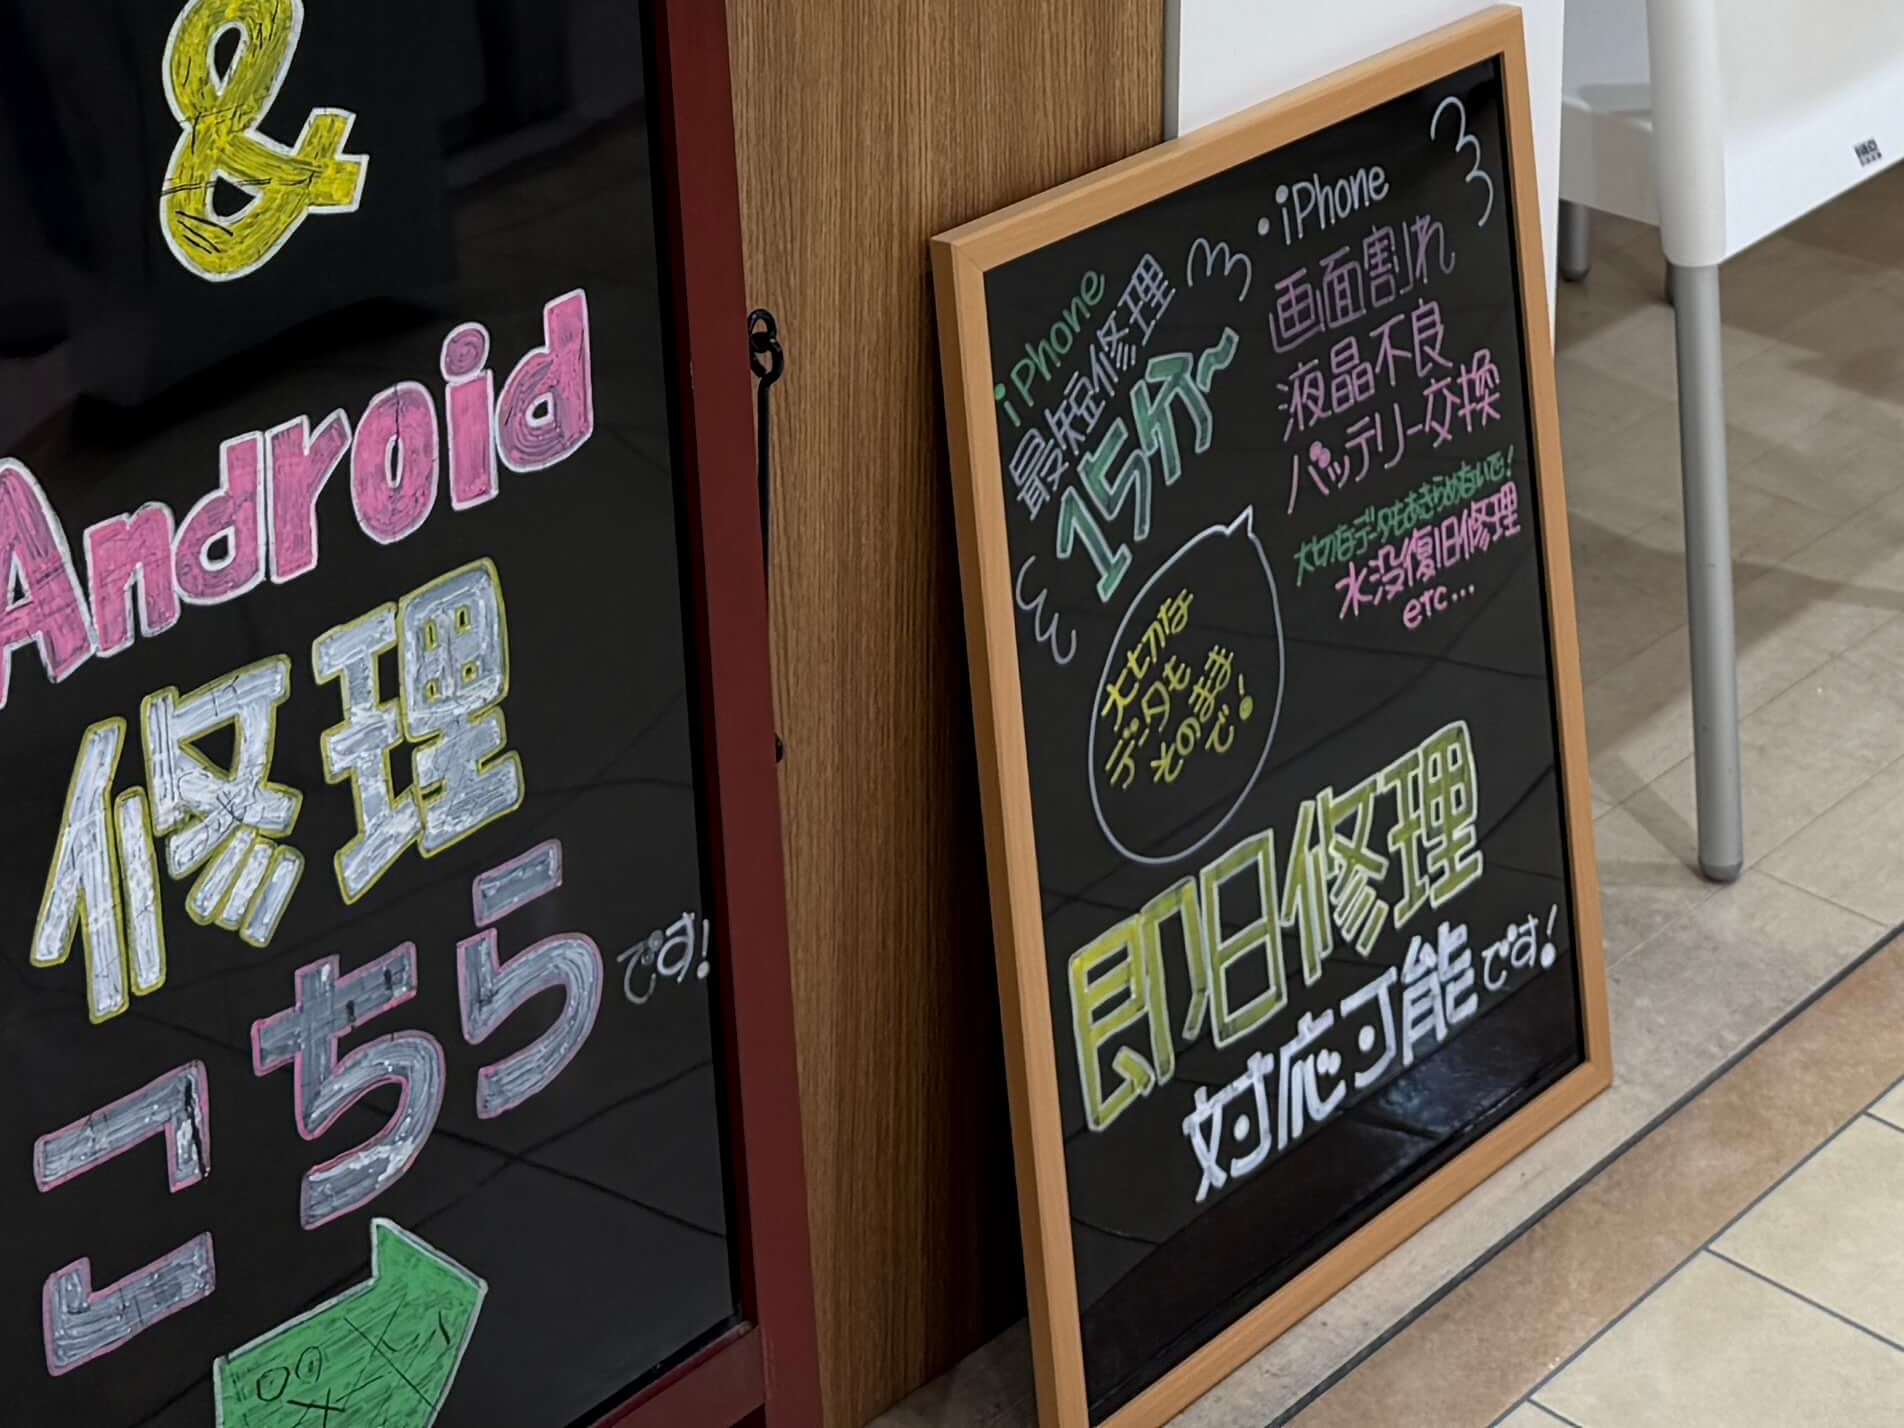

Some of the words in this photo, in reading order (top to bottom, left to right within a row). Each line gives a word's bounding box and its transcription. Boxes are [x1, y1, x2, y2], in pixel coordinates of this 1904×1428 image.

[994, 268, 1106, 427] iPhone
[1269, 213, 1456, 354] 画面割れ
[1008, 254, 1176, 521] 最短修理
[1277, 298, 1453, 443] 液晶不良
[1286, 348, 1502, 516] バッテリー交換
[1334, 481, 1522, 620] 水没復旧修理
[1100, 587, 1195, 734] 大切な
[29, 556, 526, 1023] 修理
[1068, 719, 1484, 1132] 即日修理
